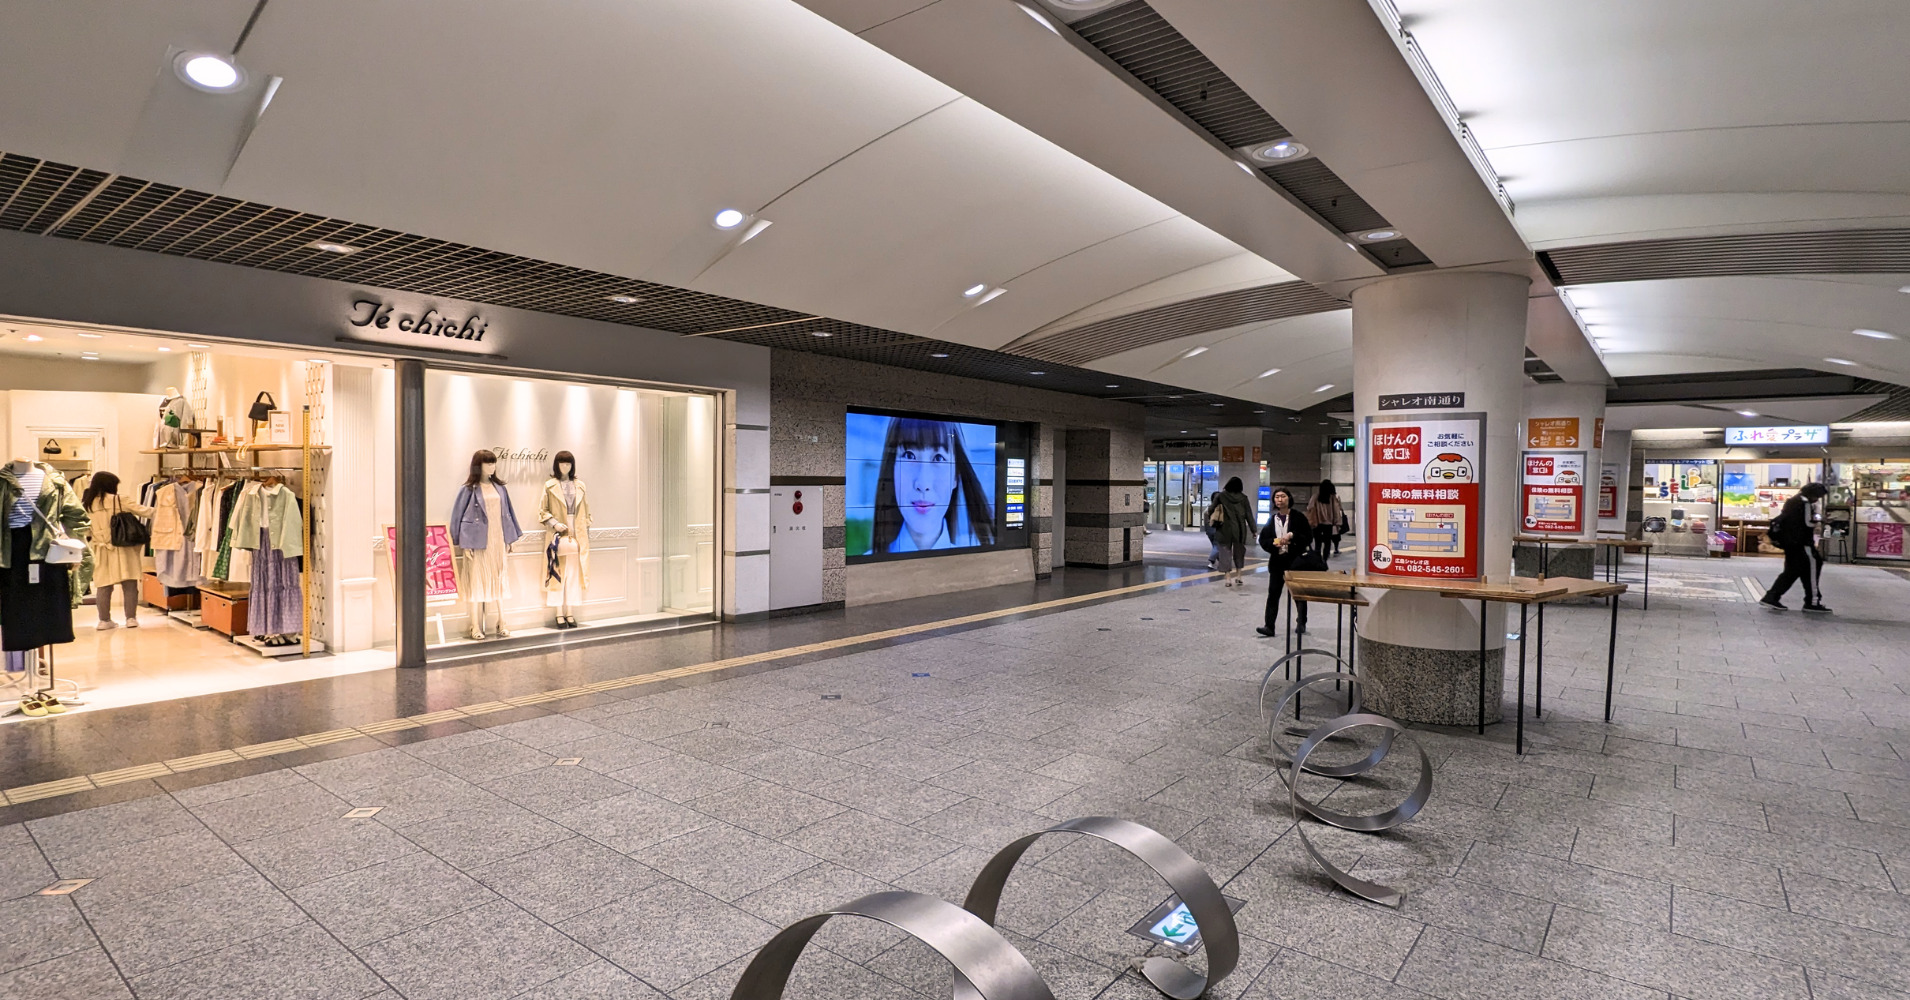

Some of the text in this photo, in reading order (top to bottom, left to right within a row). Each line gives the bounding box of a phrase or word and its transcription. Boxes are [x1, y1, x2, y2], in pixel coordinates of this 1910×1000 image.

[351, 299, 489, 341] Té chichi
[1380, 394, 1461, 407] シャレオ南通り
[1373, 433, 1419, 446] ほけんの
[1733, 428, 1823, 441] ふれ愛プラザ
[1427, 440, 1474, 448] ご相談ください
[510, 447, 548, 461] chichi
[1382, 447, 1406, 460] 窓口
[1381, 489, 1460, 500] 保険の無料相談
[1407, 564, 1465, 574] 082-545-2601
